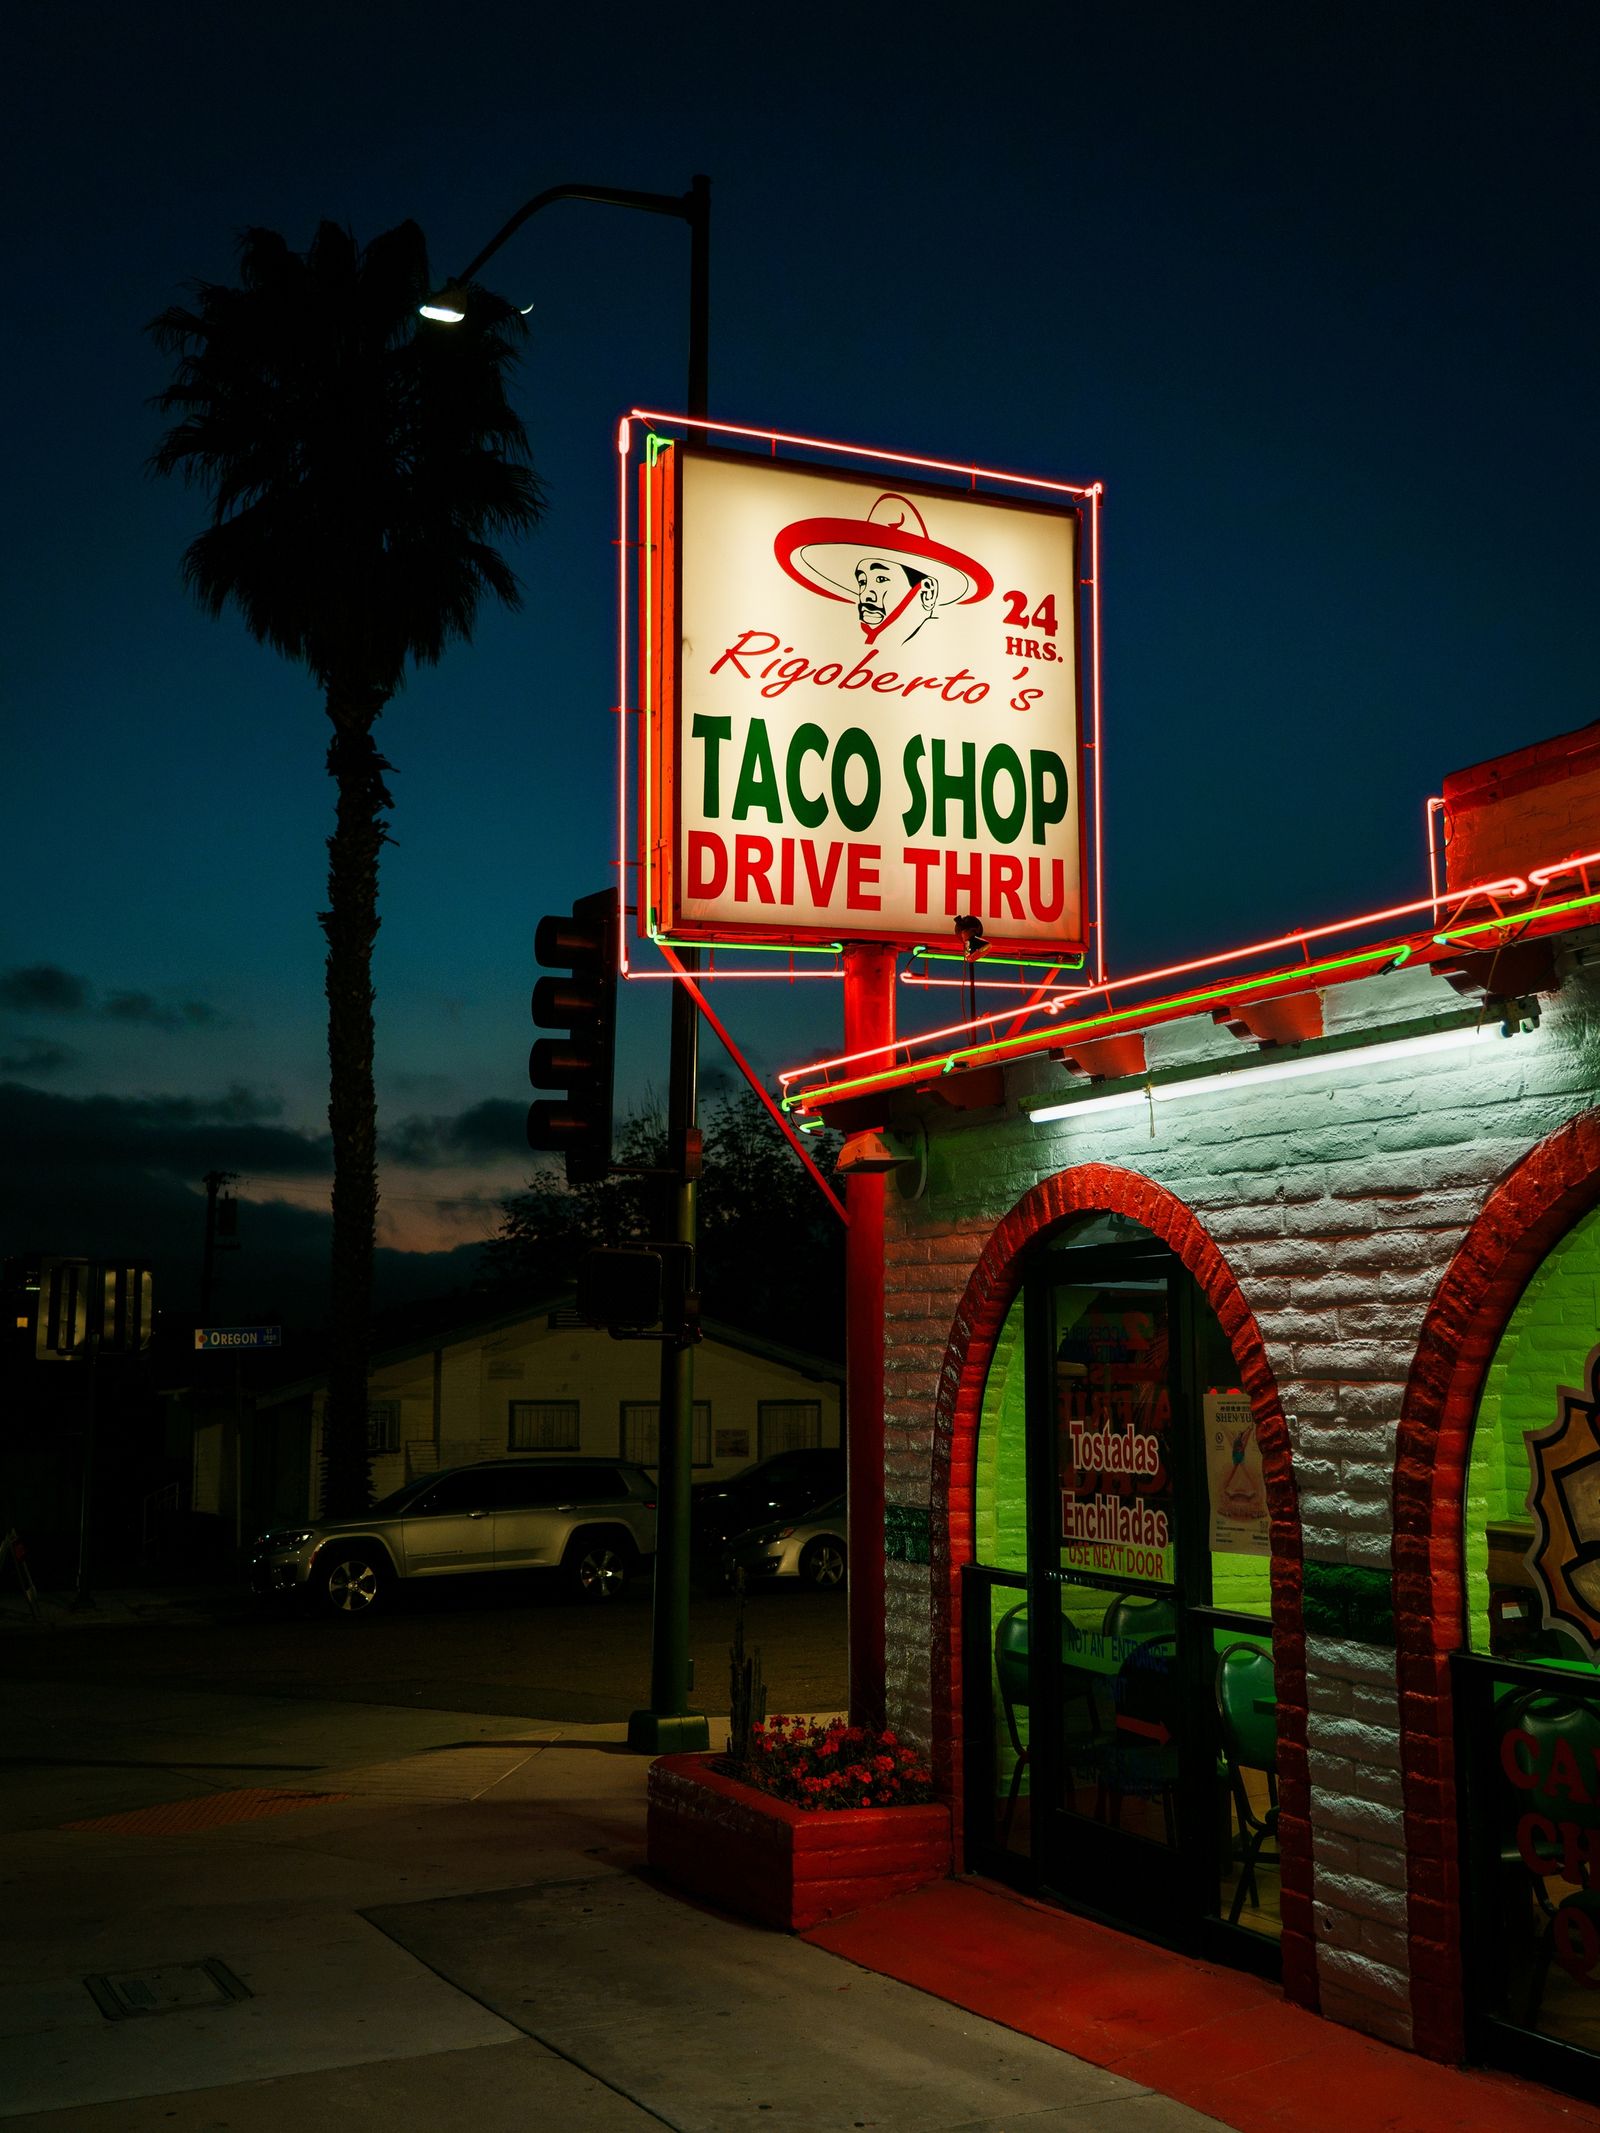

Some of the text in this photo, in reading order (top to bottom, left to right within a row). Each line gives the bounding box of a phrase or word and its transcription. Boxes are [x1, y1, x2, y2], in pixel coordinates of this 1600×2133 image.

[1002, 590, 1059, 637] 24
[709, 630, 1043, 712] Rigoberto's
[1005, 636, 1064, 663] HRS.
[692, 712, 1069, 846] TACO SHOP
[686, 830, 1066, 923] DRIVE THRU
[1216, 1412, 1238, 1423] SHEN
[1069, 1419, 1160, 1476] Tostadas
[1062, 1490, 1169, 1550] Enchiladas
[1068, 1543, 1164, 1580] USE NEXT DOOR
[1090, 1632, 1105, 1659] AN
[1500, 1727, 1600, 1806] CA
